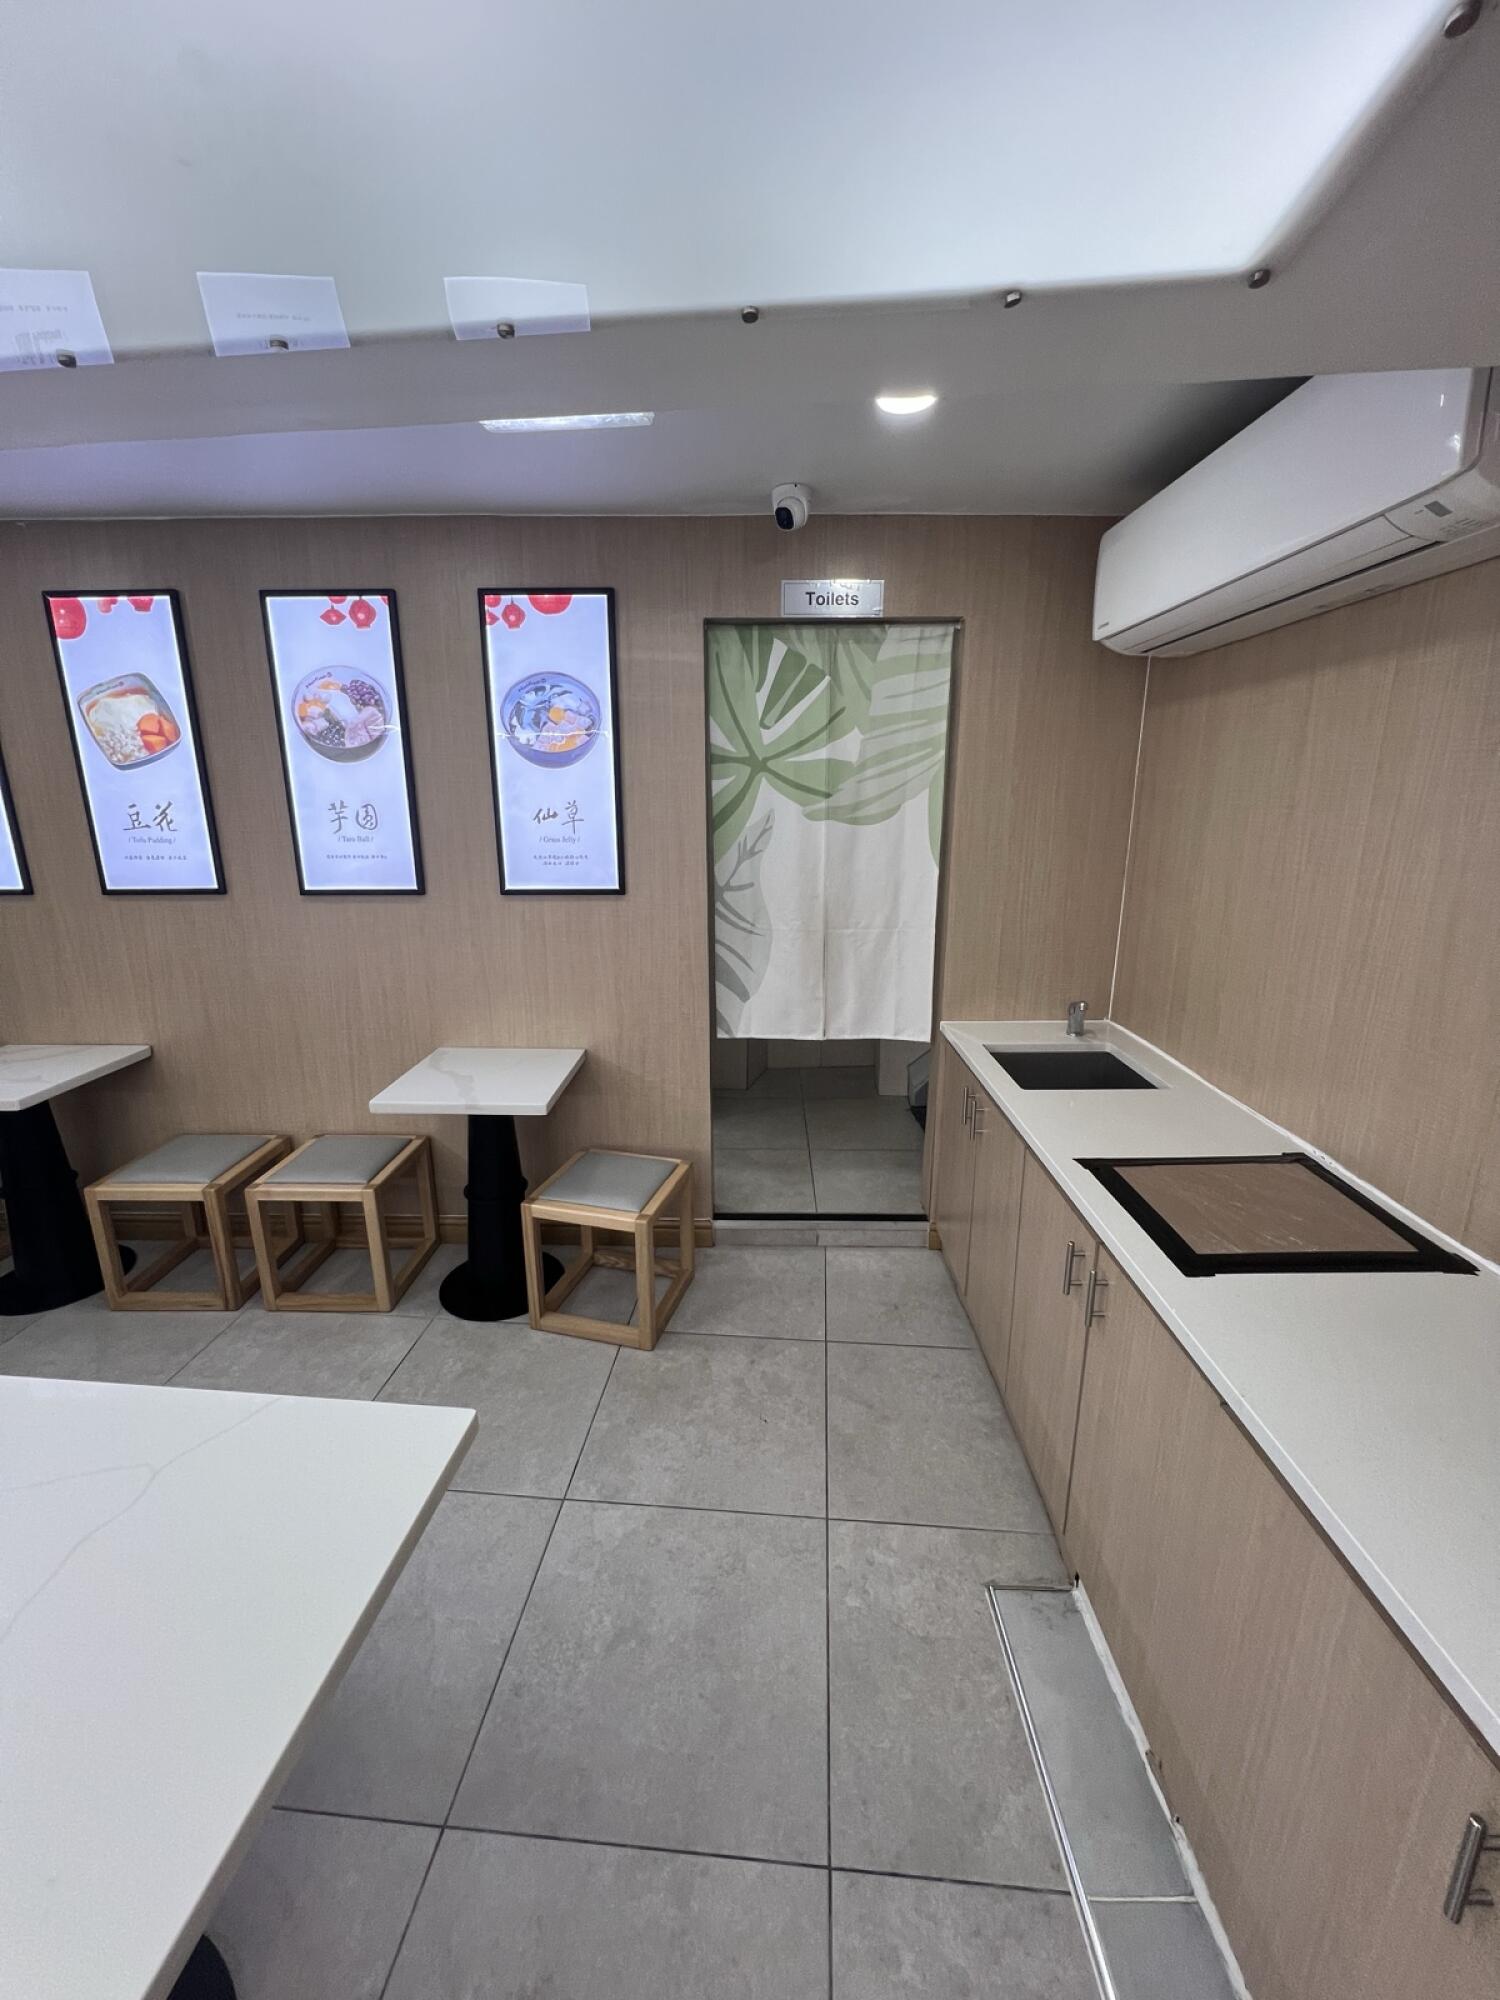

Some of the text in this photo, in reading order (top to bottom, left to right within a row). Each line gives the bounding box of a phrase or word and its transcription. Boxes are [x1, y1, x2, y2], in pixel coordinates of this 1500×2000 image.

[805, 591, 859, 606] Toilets
[123, 800, 178, 832] 豆花
[533, 800, 585, 835] 仙草
